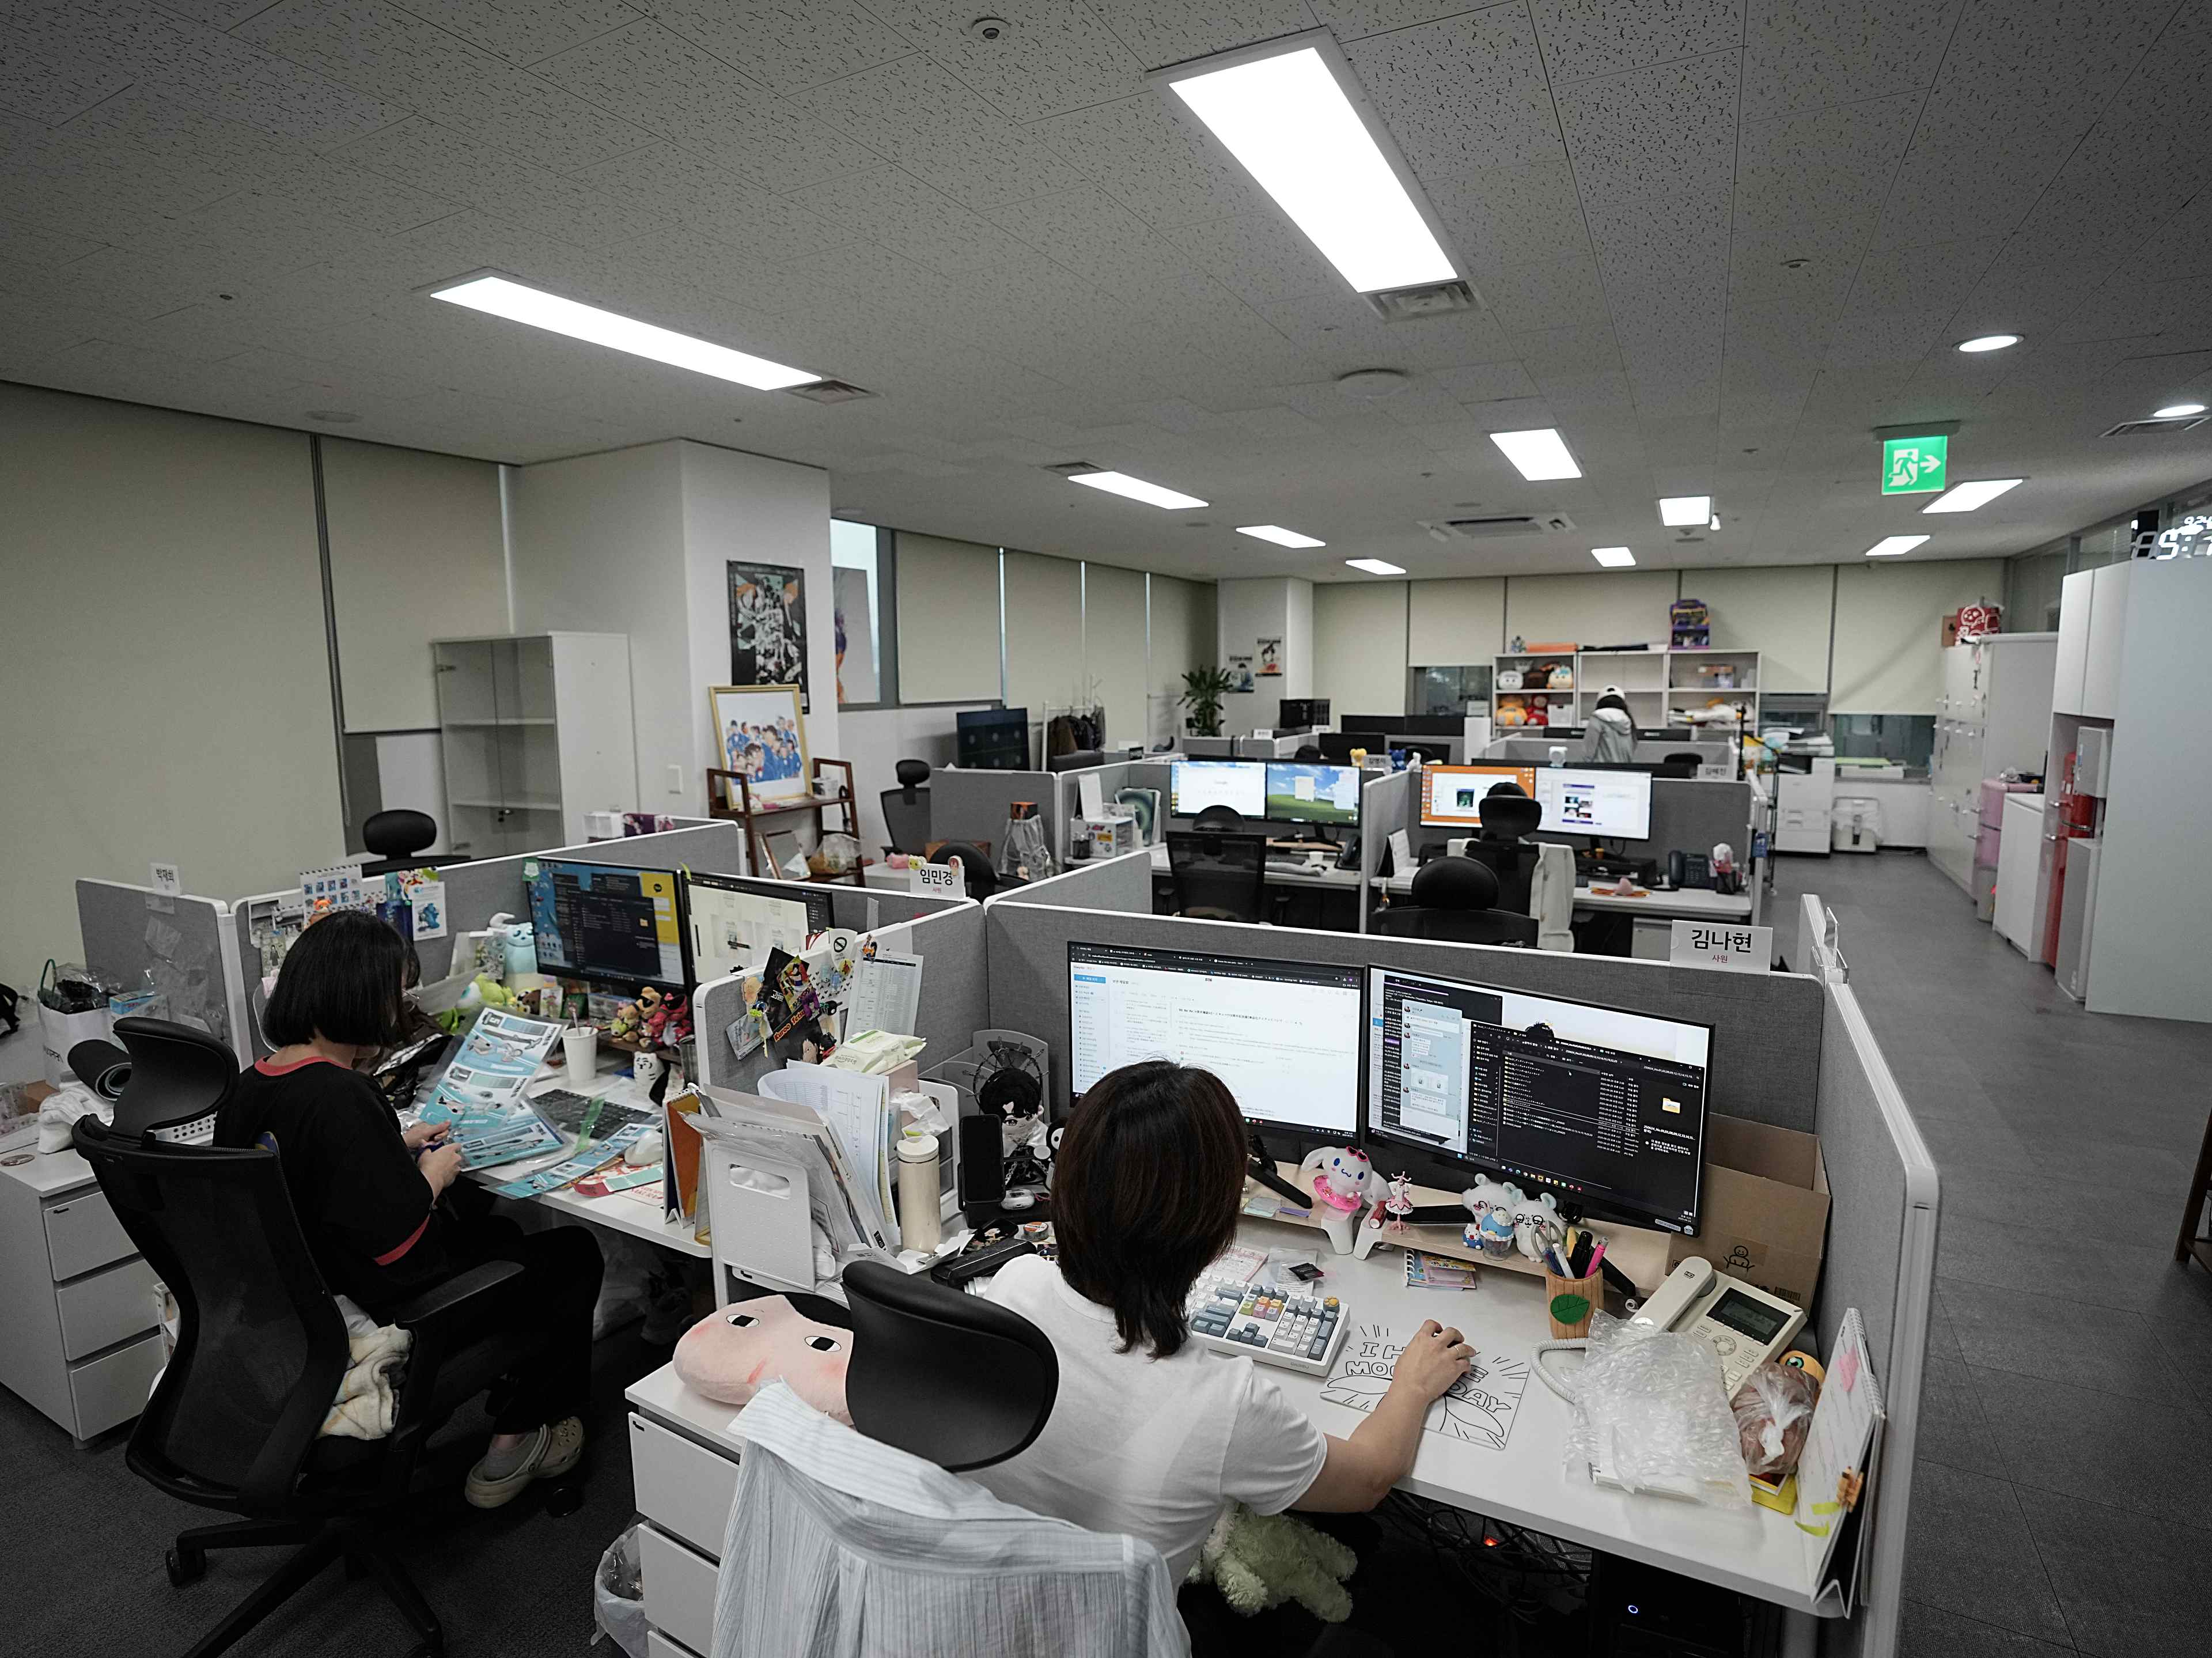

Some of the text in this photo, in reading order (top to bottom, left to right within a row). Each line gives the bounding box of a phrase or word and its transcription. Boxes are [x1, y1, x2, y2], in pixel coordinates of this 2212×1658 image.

[920, 869, 953, 885] 임민경
[1691, 929, 1752, 953] 김나현
[1712, 955, 1728, 963] 사원
[790, 1009, 806, 1025] Tetsu
[1359, 1342, 1379, 1357] I
